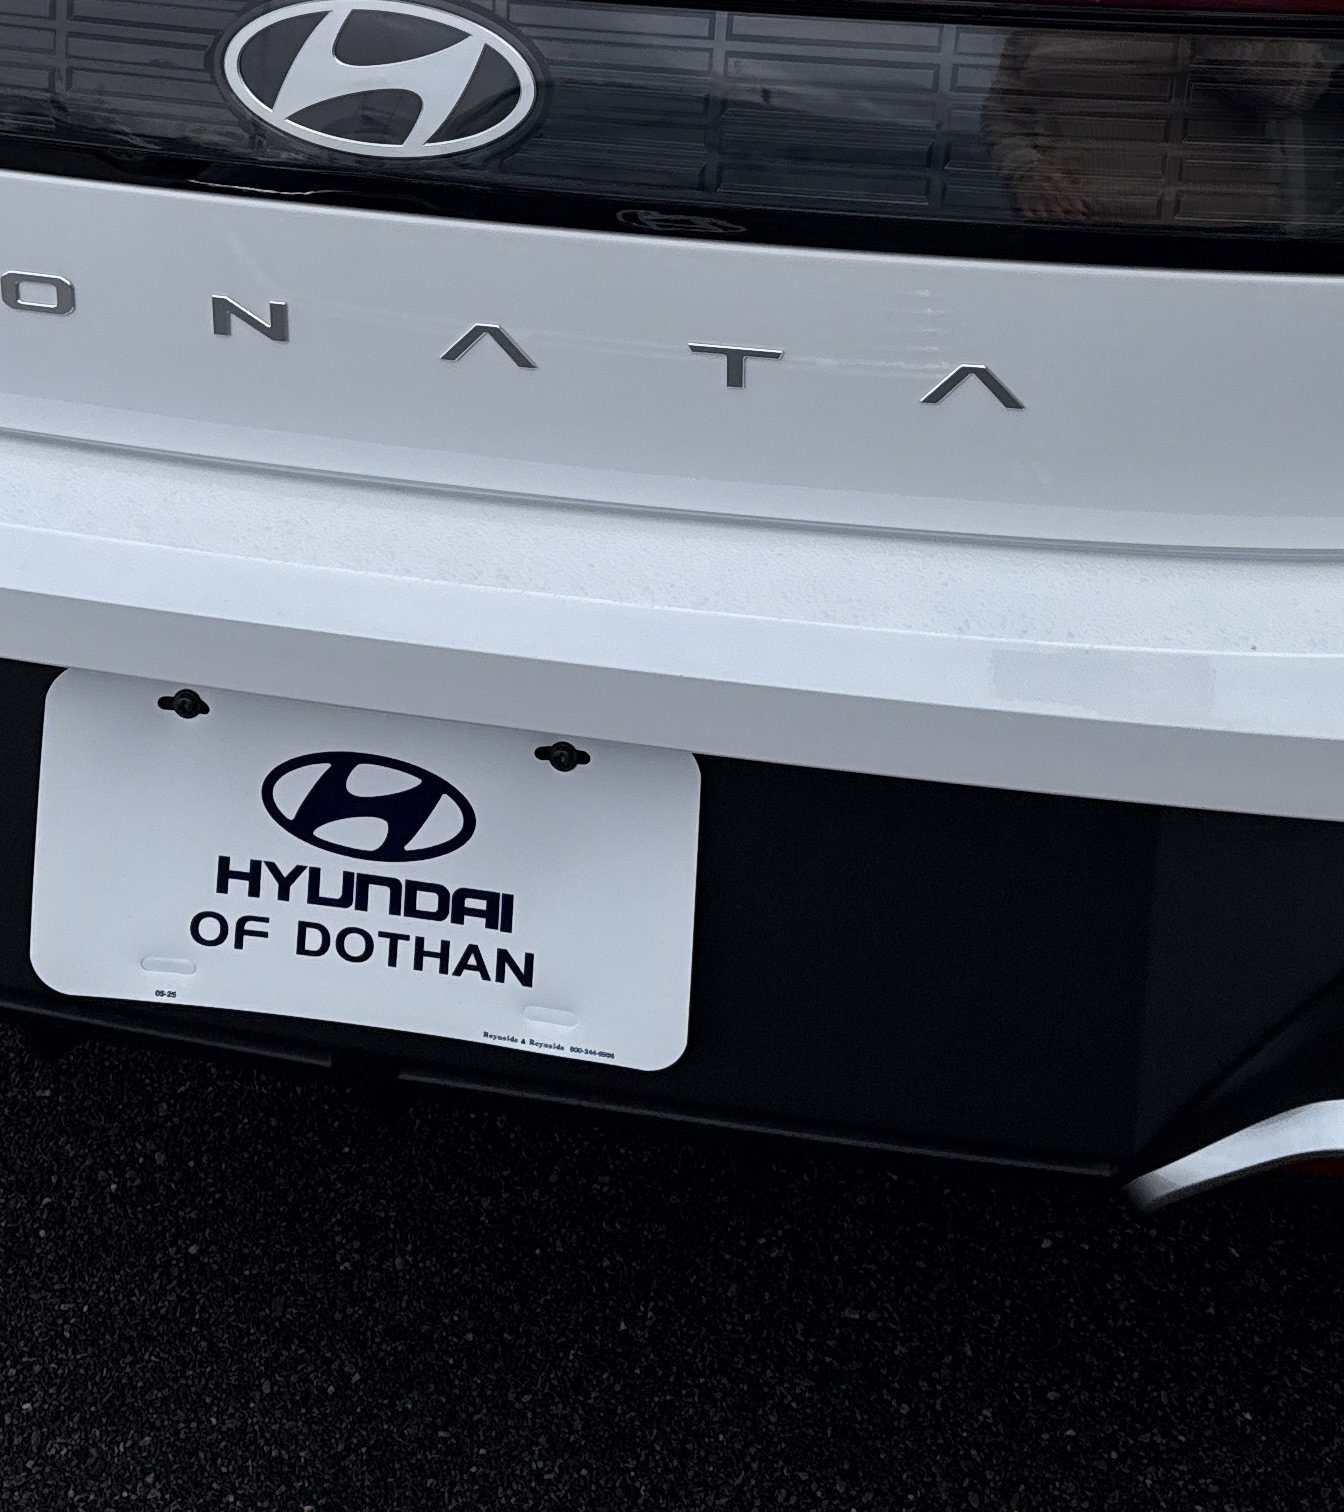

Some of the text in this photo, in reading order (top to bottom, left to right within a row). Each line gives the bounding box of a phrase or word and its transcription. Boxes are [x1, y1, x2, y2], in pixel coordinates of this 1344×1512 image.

[216, 855, 514, 934] HYUNDAI
[189, 910, 535, 988] OF DOTHAN
[482, 1030, 519, 1045] Reynolds
[529, 1038, 565, 1052] Reynolds
